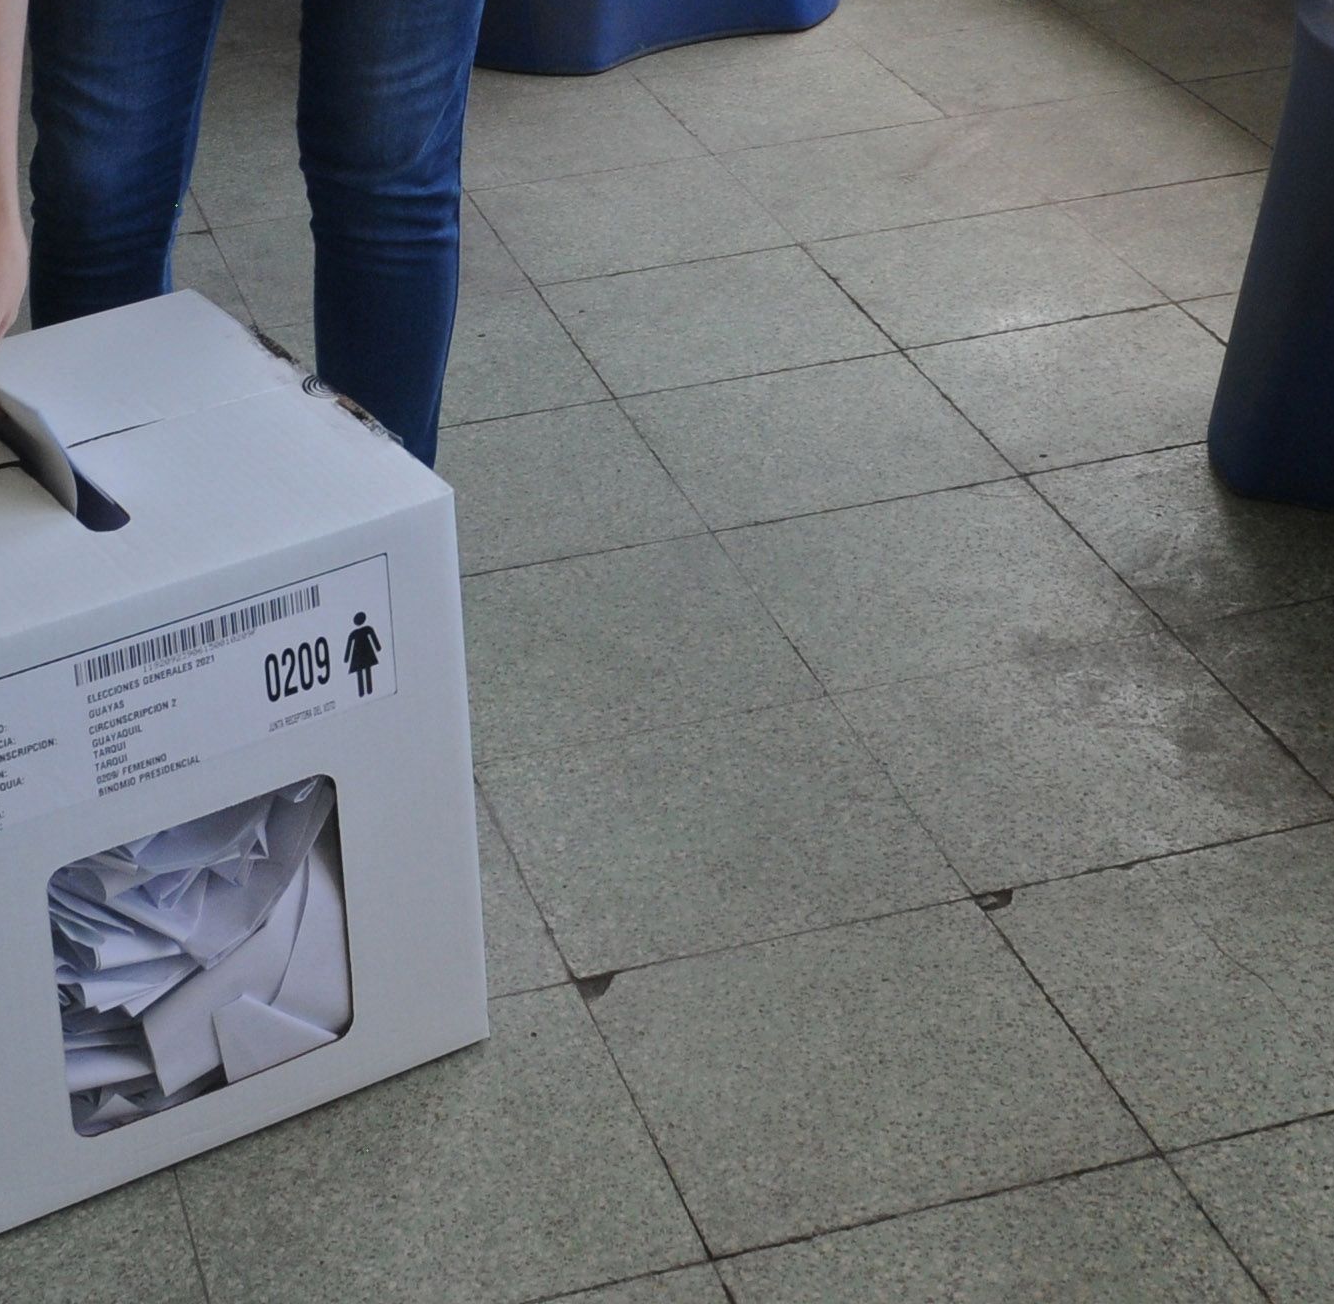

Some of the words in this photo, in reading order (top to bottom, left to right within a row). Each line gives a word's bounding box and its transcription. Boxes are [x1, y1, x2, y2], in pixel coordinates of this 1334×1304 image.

[87, 679, 140, 704] ELECCIONES
[142, 662, 193, 685] GENERALES
[196, 655, 215, 668] 2021
[265, 636, 330, 702] 0209
[88, 700, 125, 719] GUAYAS
[88, 699, 169, 735] CIRCUNSCRIPCION
[171, 698, 177, 707] 2
[92, 725, 143, 748] GUAYAQUIL
[93, 741, 126, 759] TARQUI
[95, 754, 128, 772] TARQUI
[122, 753, 167, 775] FEMENINO
[98, 777, 136, 797] BINOMIO
[139, 755, 201, 783] PRESIDENCIAL
